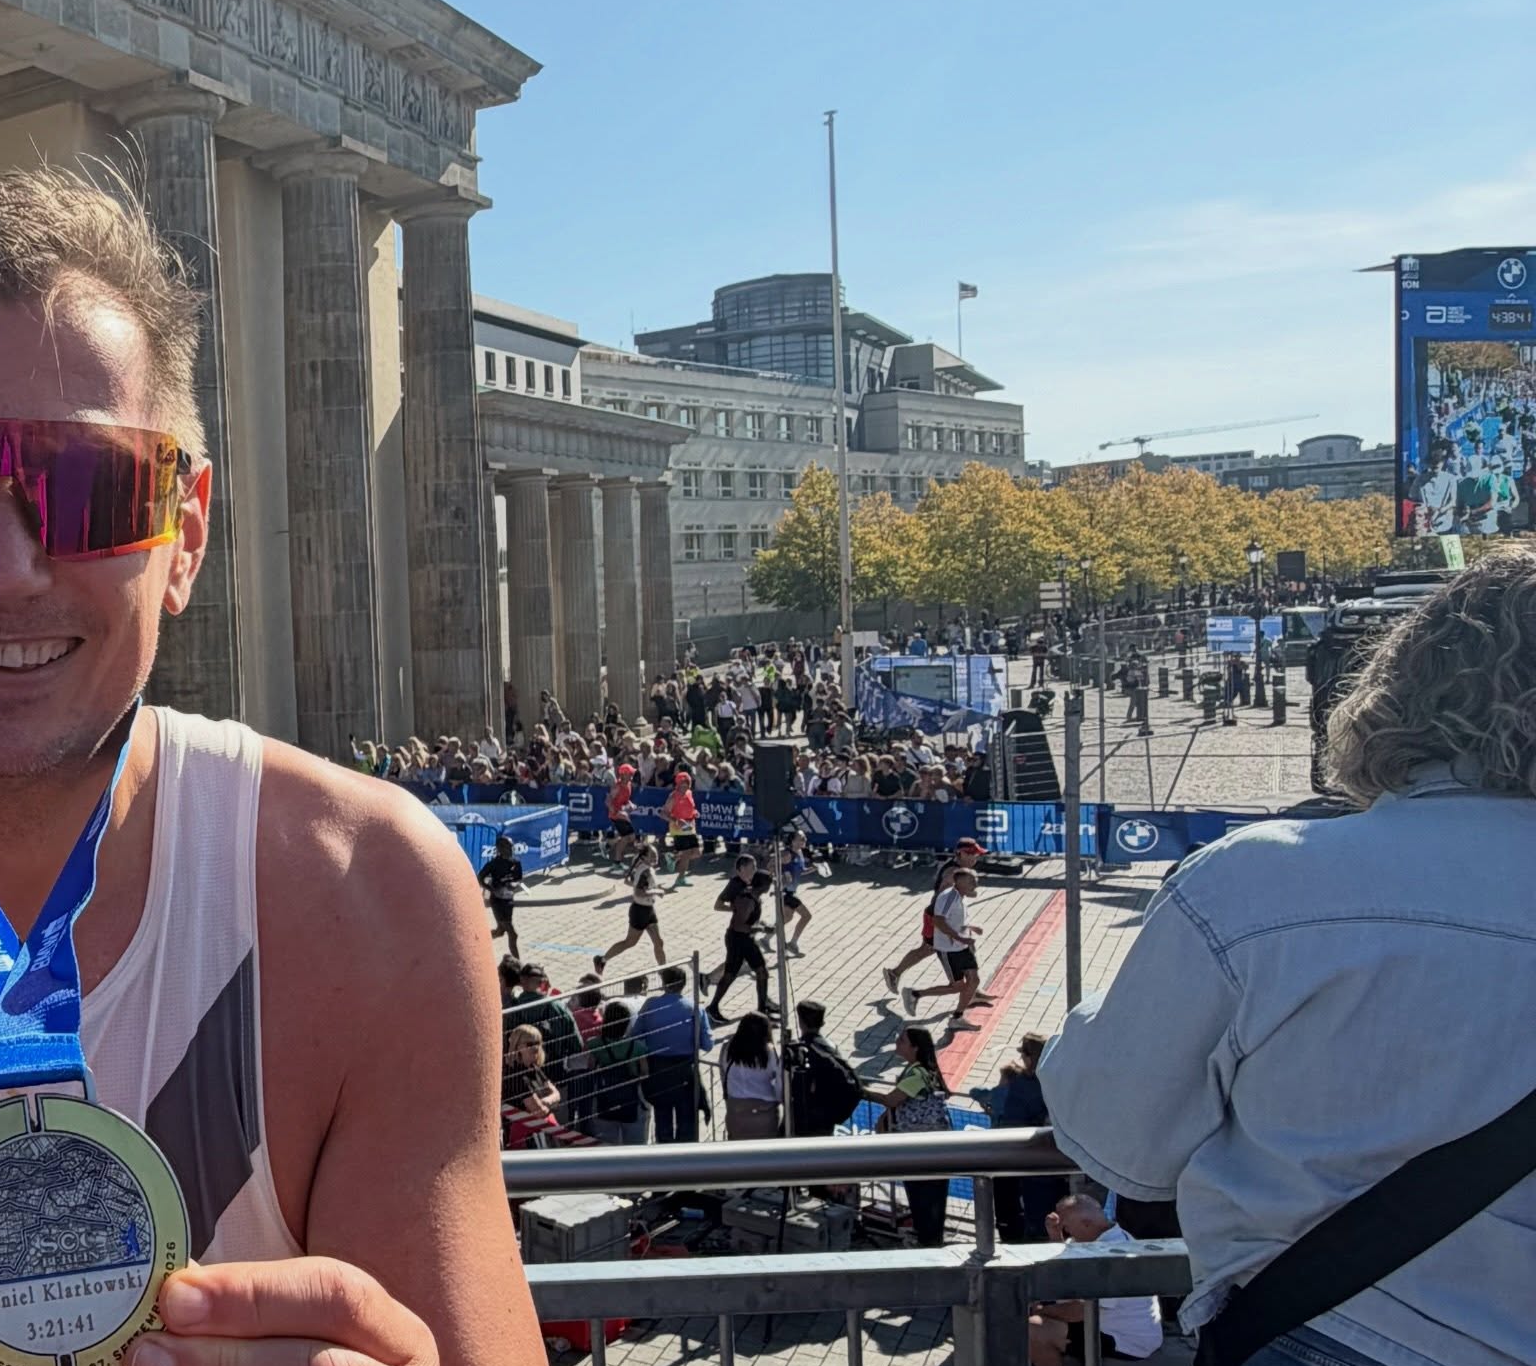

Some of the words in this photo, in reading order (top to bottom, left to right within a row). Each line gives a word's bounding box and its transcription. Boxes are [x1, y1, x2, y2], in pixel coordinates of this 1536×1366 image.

[701, 803, 733, 815] BMW
[43, 1269, 144, 1301] Klarkowski
[26, 1312, 95, 1342] 3:21:41
